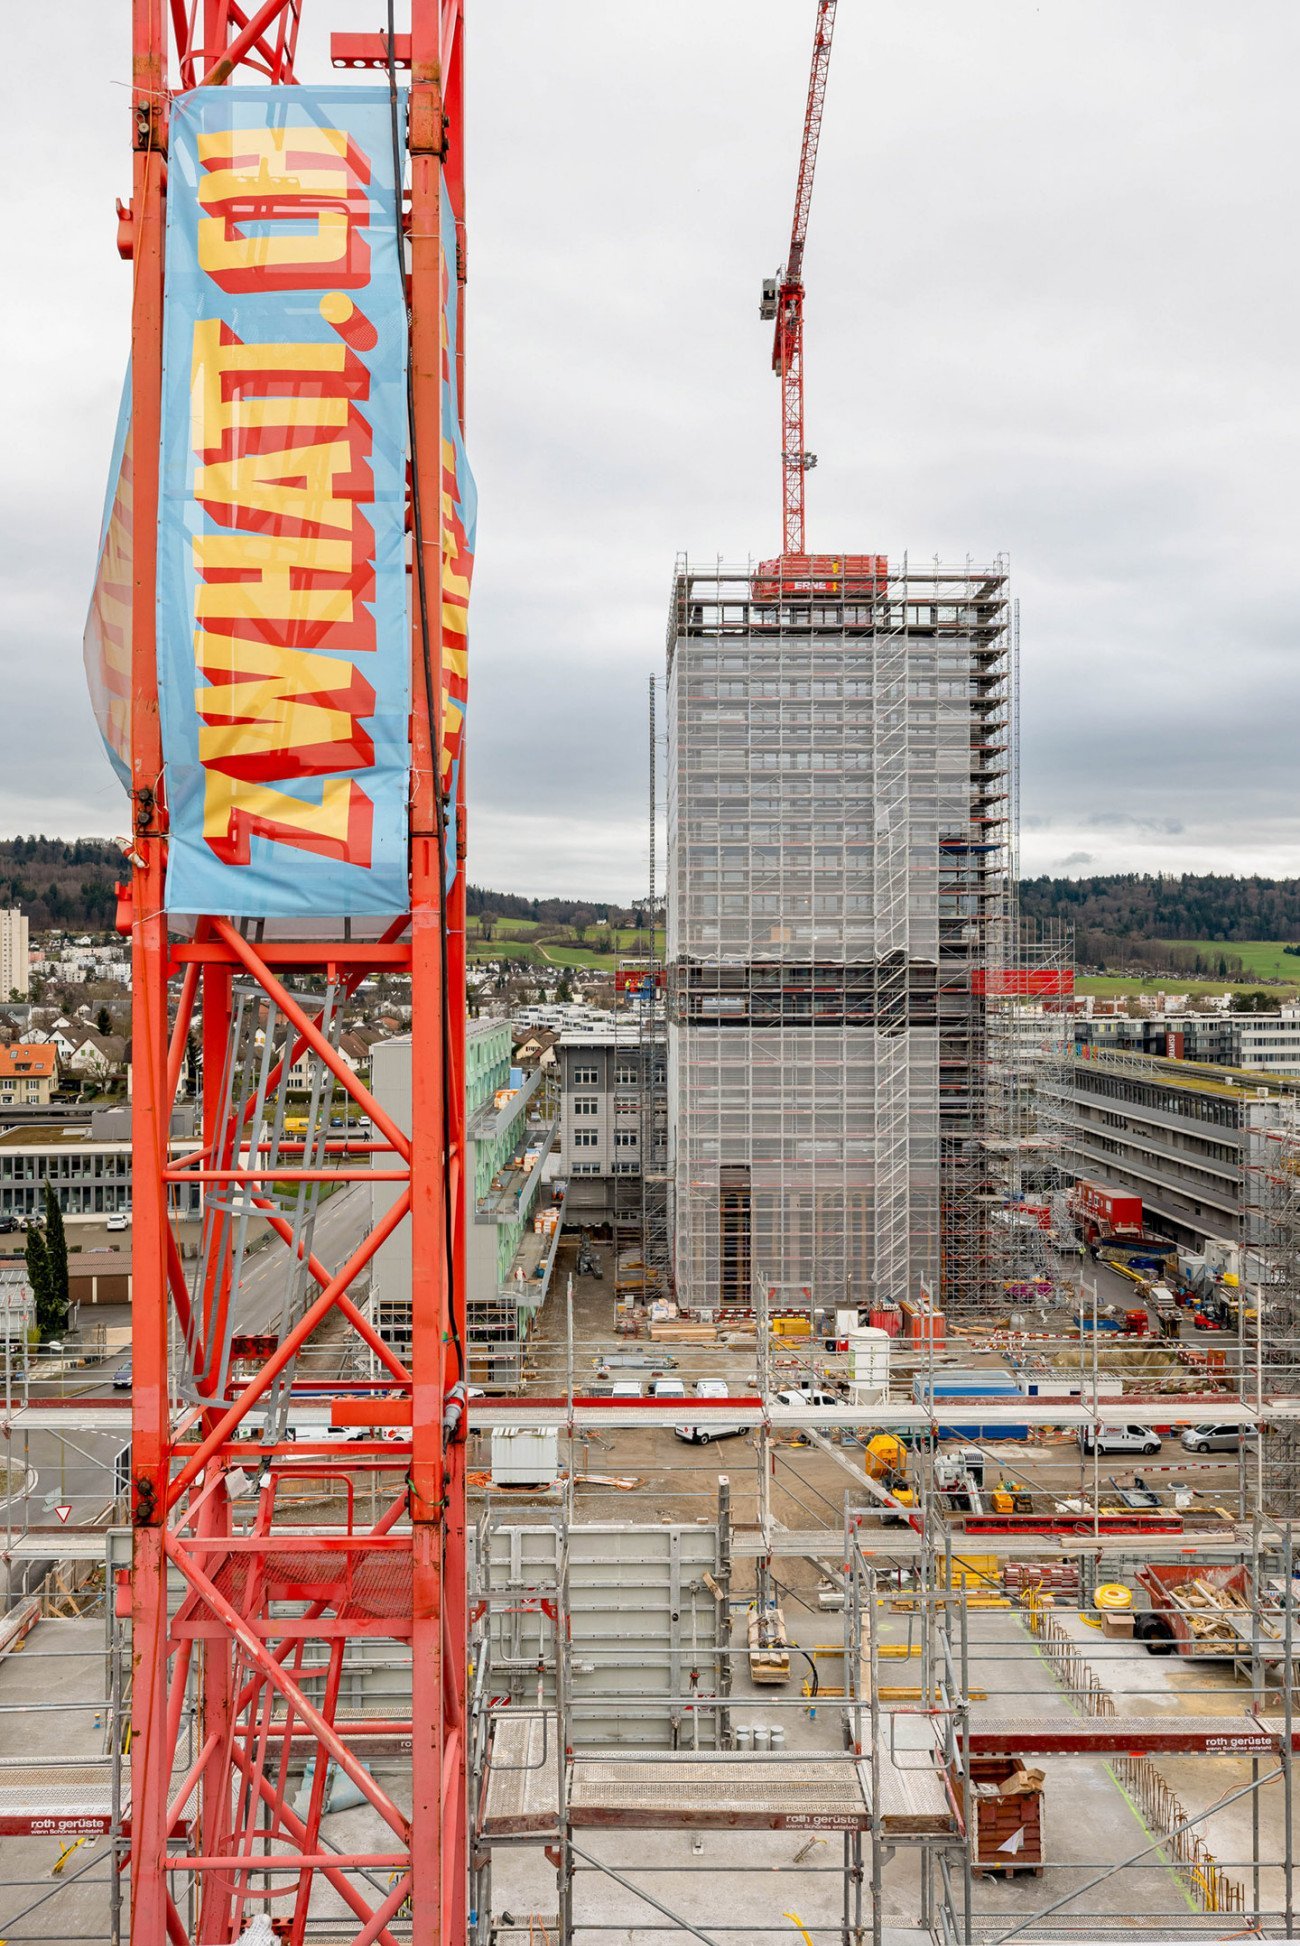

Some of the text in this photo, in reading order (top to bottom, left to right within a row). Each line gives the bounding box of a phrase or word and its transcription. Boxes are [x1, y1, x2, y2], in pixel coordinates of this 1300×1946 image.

[192, 127, 378, 869] ZWHATT.CH
[794, 581, 827, 590] ERNE
[1205, 1736, 1272, 1747] roth gerüste
[31, 1818, 104, 1830] roth gerüste
[786, 1814, 859, 1825] roth gerüste
